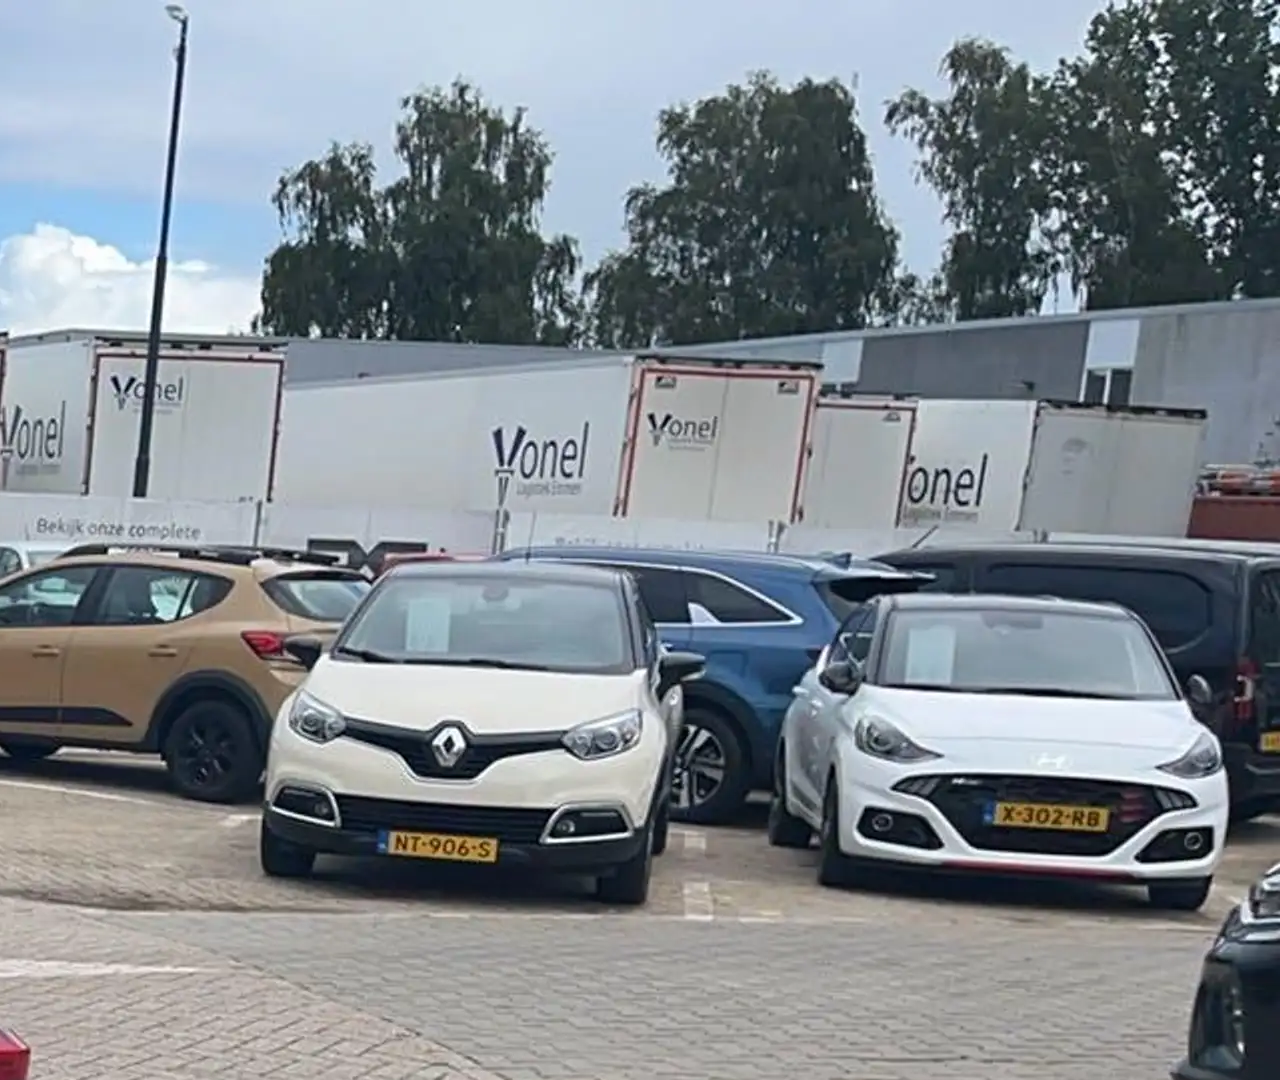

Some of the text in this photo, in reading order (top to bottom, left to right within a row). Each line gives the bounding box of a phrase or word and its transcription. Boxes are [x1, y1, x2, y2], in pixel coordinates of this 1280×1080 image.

[1, 400, 66, 460] Vonel
[647, 412, 718, 438] Vonel
[493, 421, 589, 480] Vonel
[907, 453, 988, 507] onel
[36, 517, 202, 541] Bekijk onze complete
[1002, 806, 1101, 828] X-302-RB
[393, 833, 491, 858] NT-906-S
